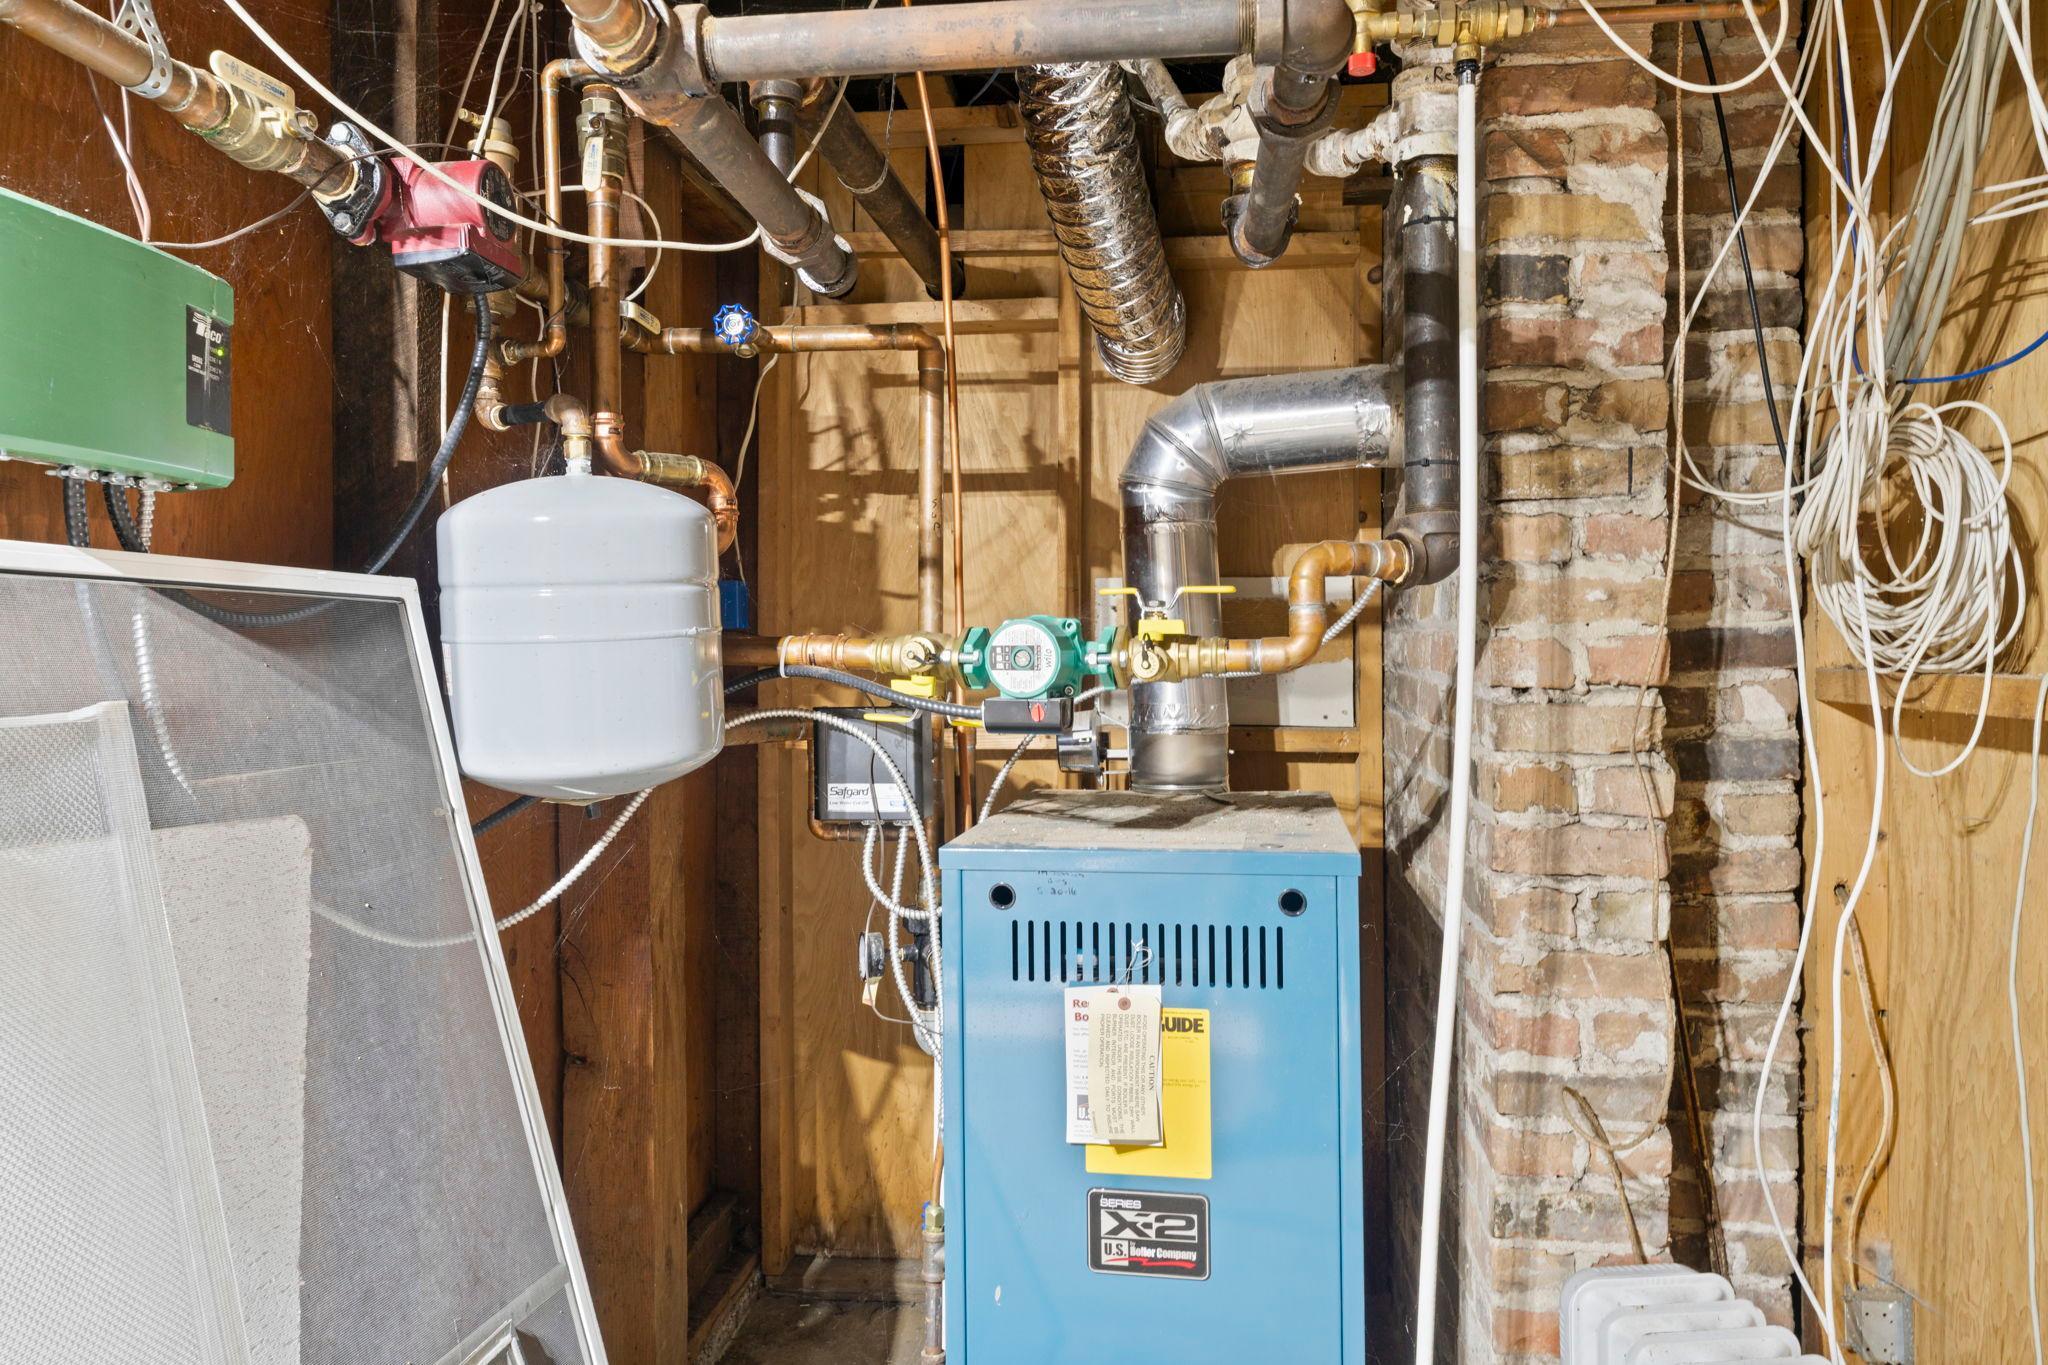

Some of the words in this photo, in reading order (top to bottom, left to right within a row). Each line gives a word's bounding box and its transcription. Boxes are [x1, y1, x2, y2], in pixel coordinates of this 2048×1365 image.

[1433, 66, 1454, 82] Re
[193, 312, 223, 344] Taco
[1045, 648, 1053, 669] wilo
[829, 786, 870, 799] Safgard
[1073, 999, 1089, 1008] Re
[1074, 1011, 1089, 1022] Bo
[1100, 1198, 1142, 1209] SERIES
[1104, 1242, 1127, 1257] U.S.
[1130, 1246, 1156, 1258] Boiler
[1156, 1248, 1197, 1261] Company
